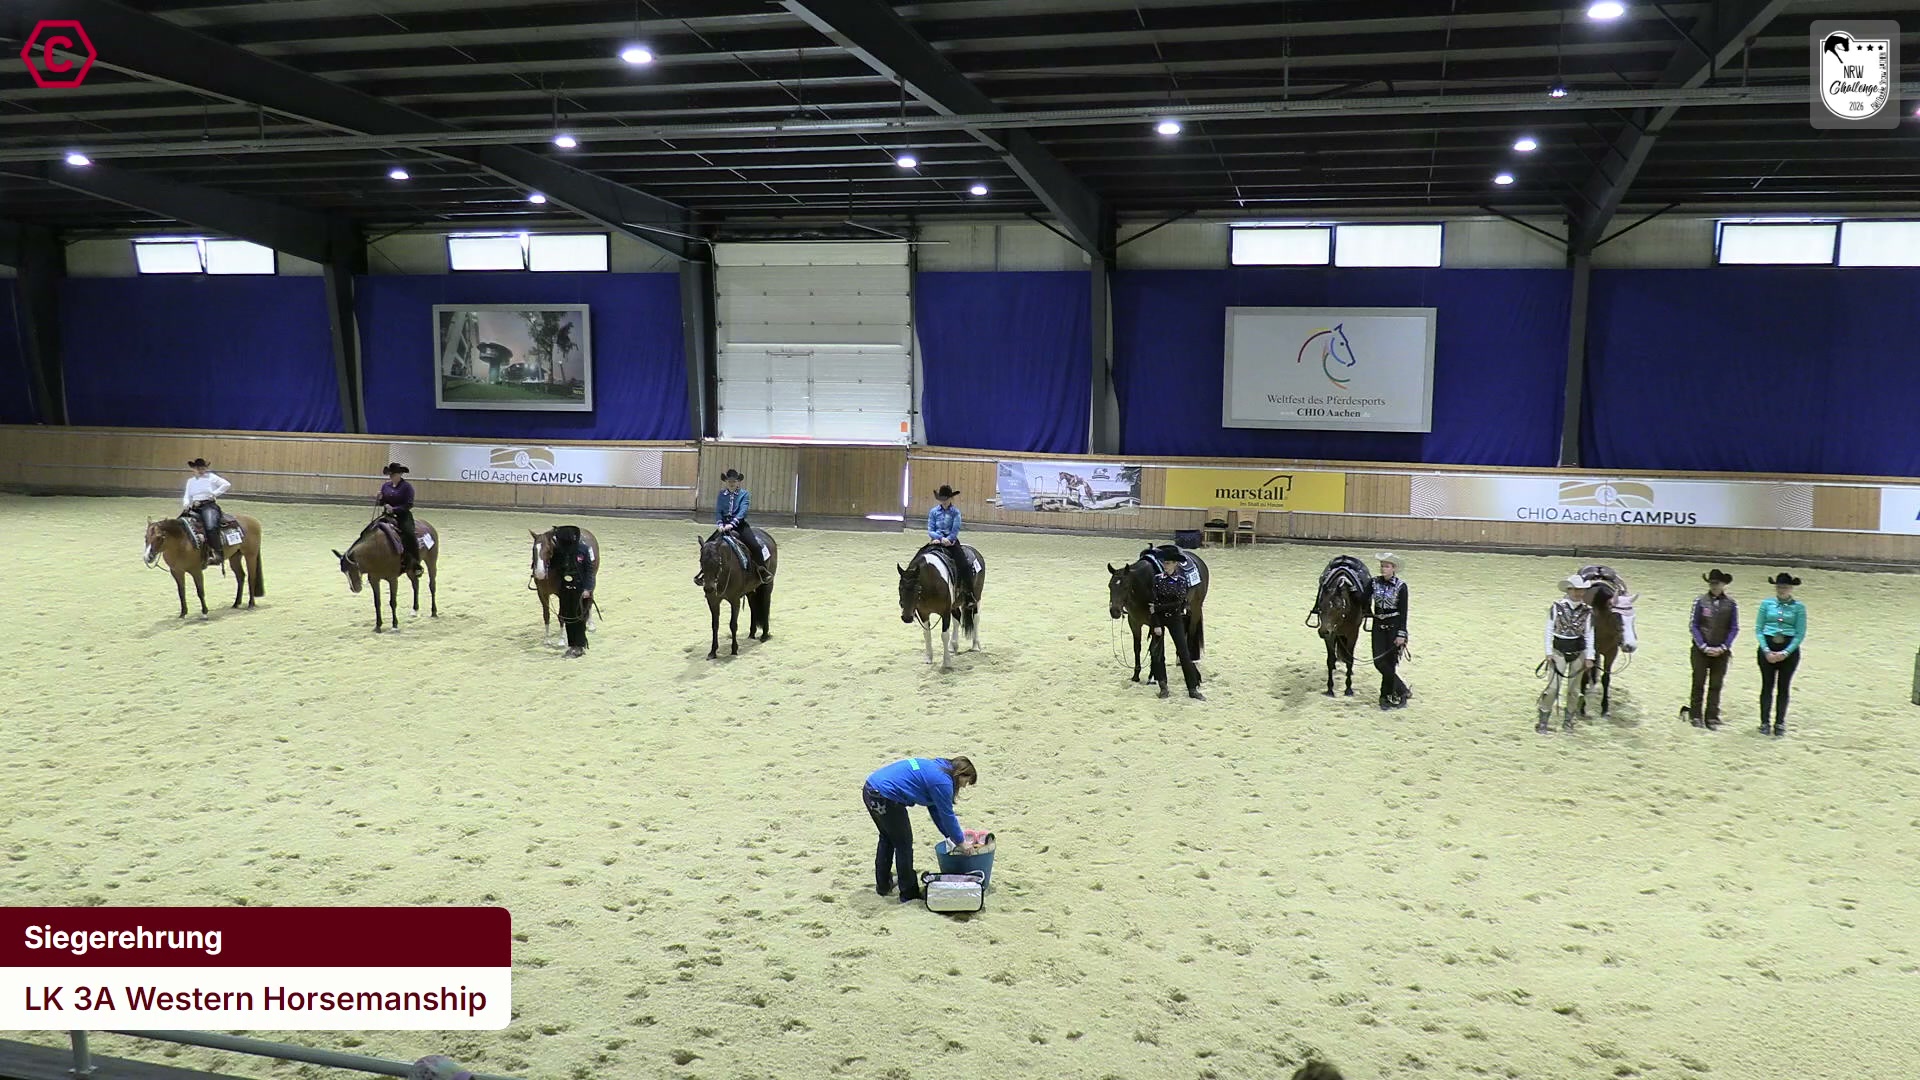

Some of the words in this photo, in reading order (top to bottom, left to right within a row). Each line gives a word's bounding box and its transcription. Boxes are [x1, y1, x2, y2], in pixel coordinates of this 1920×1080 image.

[1267, 394, 1305, 405] Weltfest
[1307, 396, 1323, 405] des
[1326, 395, 1386, 407] Pferdesports
[1296, 407, 1325, 417] CHIO
[1326, 408, 1361, 418] Aachen
[460, 469, 490, 481] CHIO
[491, 470, 529, 483] Aachen
[531, 471, 583, 484] CAMPUS
[1215, 486, 1284, 501] marstall
[1516, 506, 1558, 521] CHIO
[1561, 508, 1618, 523] Aachen
[1620, 510, 1697, 526] CAMPUS
